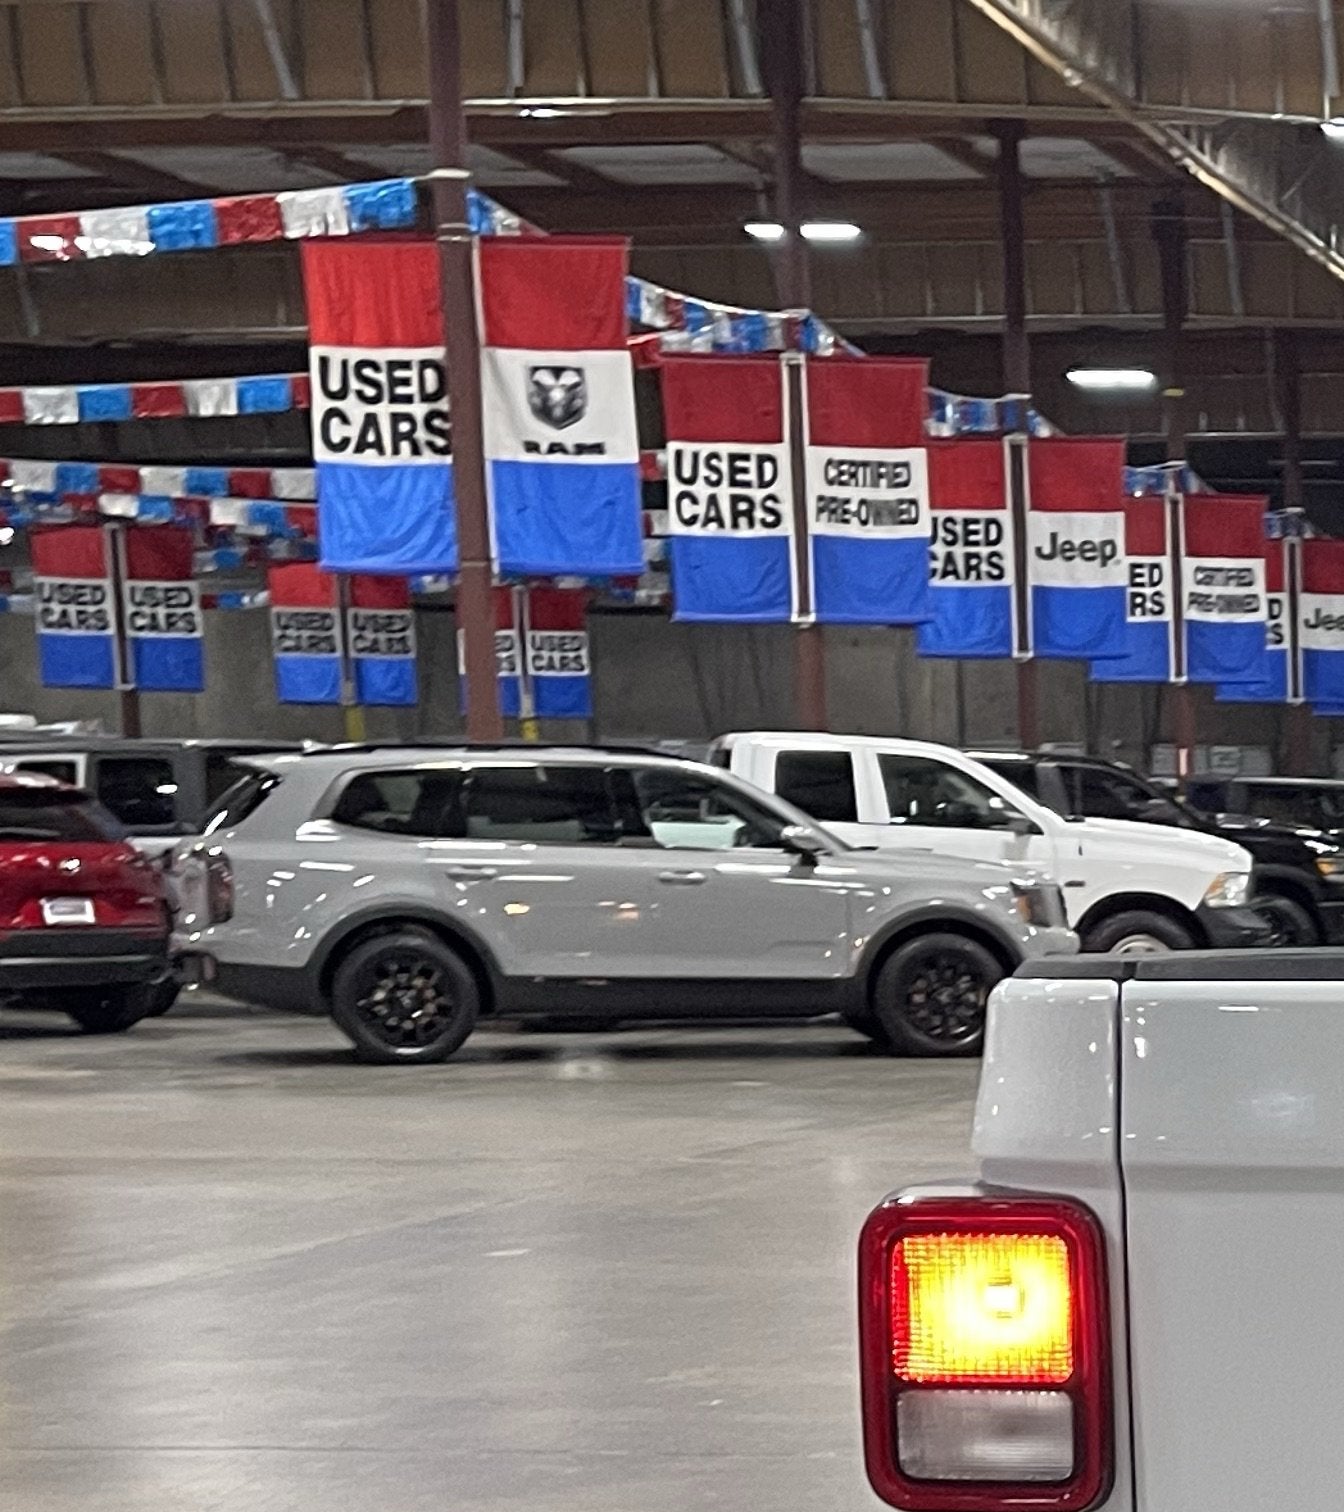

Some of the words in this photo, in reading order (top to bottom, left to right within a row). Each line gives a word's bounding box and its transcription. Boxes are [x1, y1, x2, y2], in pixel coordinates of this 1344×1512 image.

[318, 355, 447, 404] USED
[320, 406, 452, 456] CARS
[674, 449, 778, 489] USED
[675, 490, 782, 530] CARS
[1034, 531, 1118, 568] Jeep
